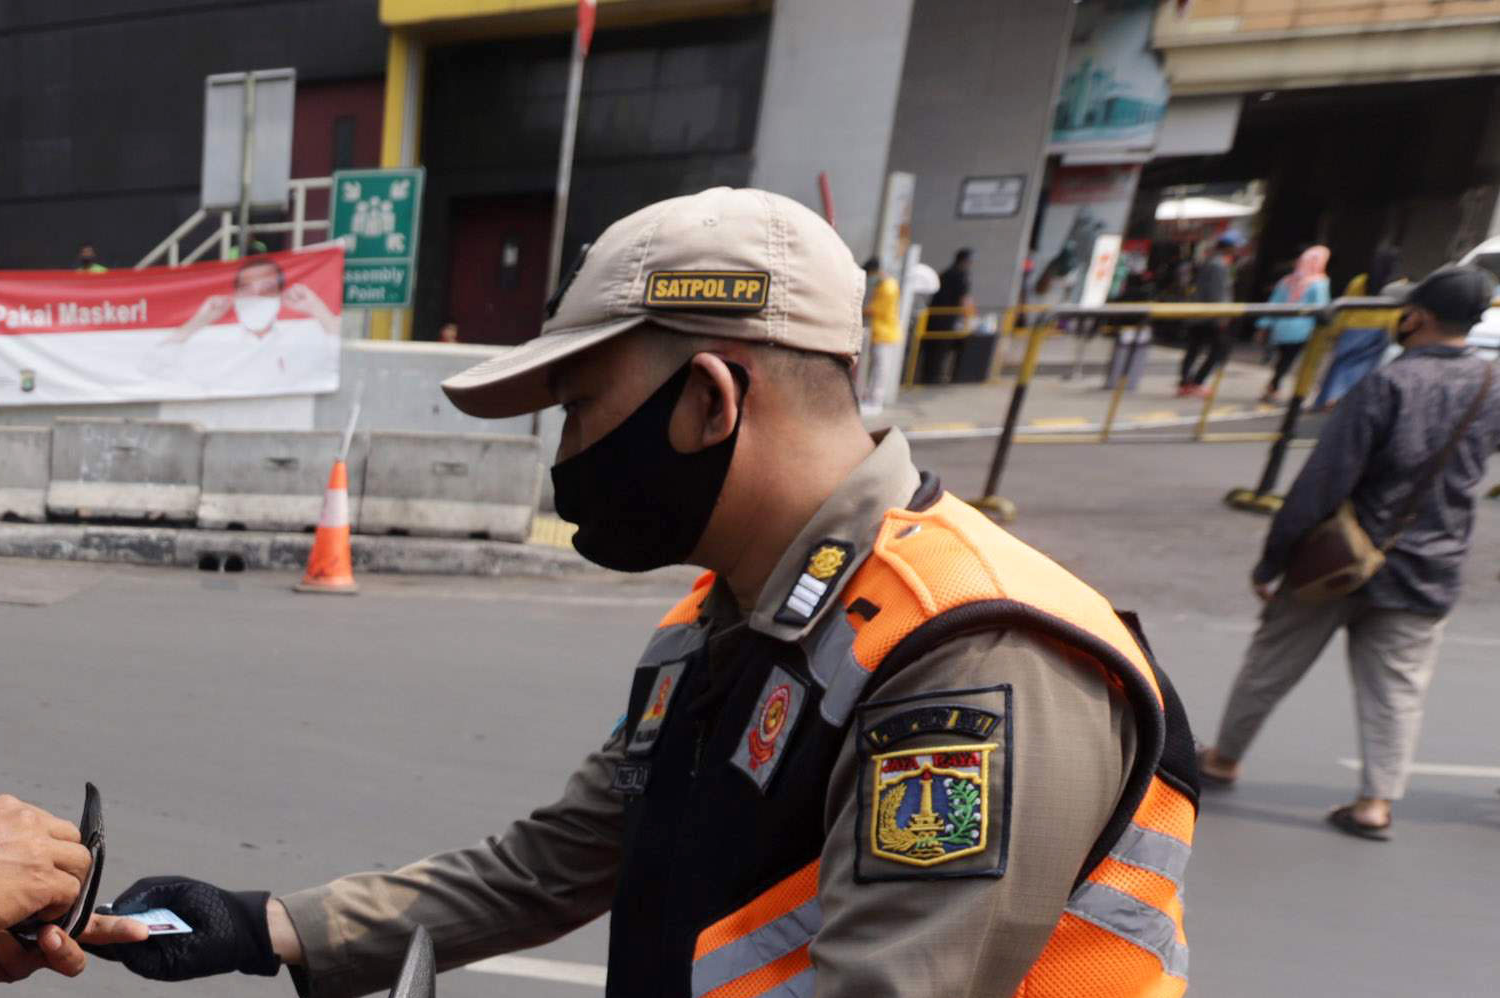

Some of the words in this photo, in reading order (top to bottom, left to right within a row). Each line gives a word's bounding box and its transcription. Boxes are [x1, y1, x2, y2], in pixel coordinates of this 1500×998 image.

[344, 266, 405, 288] ssembly
[655, 279, 727, 298] SATPOL
[732, 279, 761, 299] PP
[58, 298, 148, 326] Masker!
[882, 756, 920, 772] JAYA
[933, 751, 981, 769] RAYA
